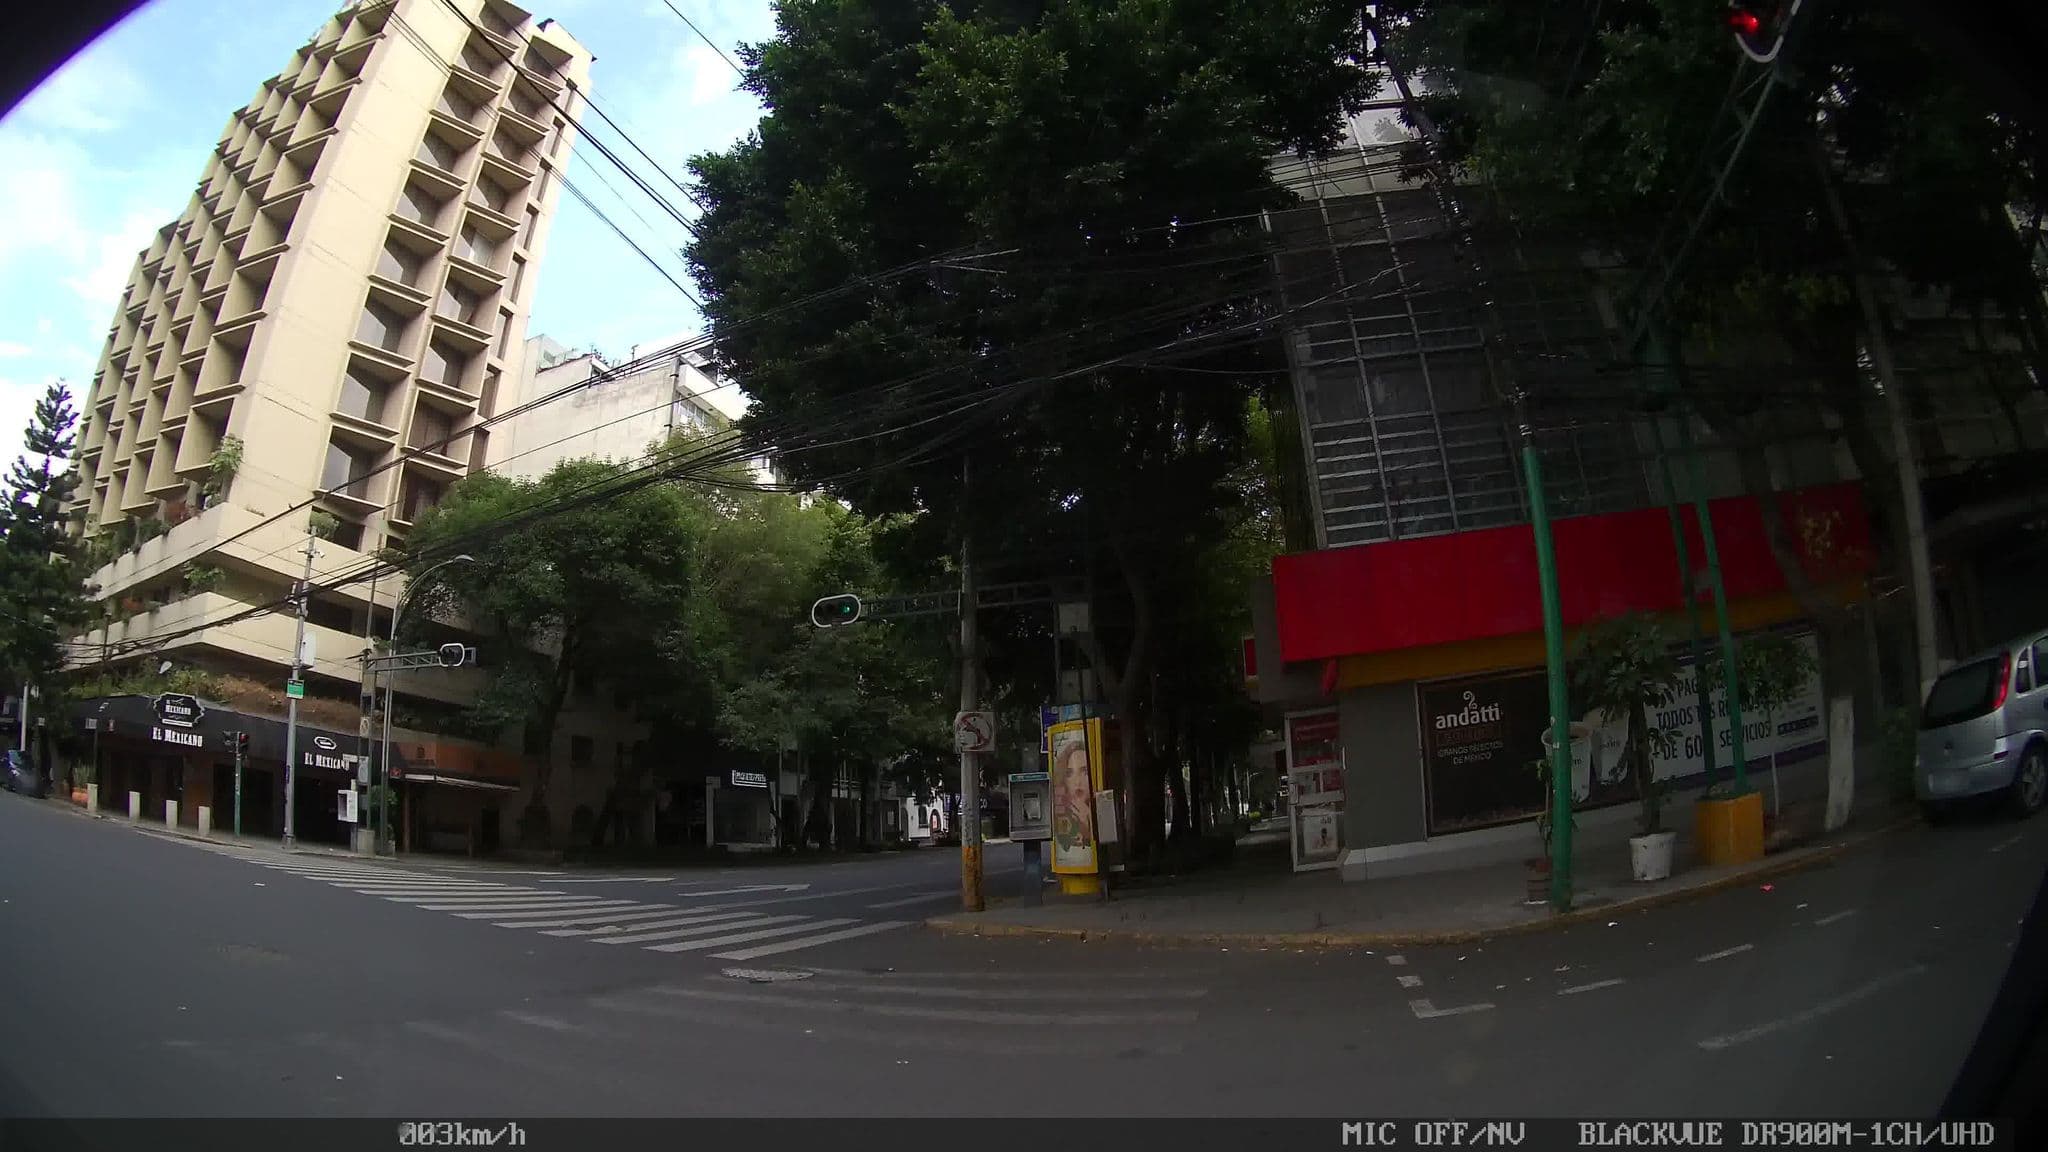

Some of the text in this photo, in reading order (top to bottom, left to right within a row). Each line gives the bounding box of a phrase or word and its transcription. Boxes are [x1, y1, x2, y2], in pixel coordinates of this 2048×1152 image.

[1435, 702, 1502, 731] andatti
[1656, 705, 1693, 731] TODOS
[152, 726, 204, 748] EL MEXICANO
[1685, 734, 1703, 759] 60
[304, 752, 314, 766] EL
